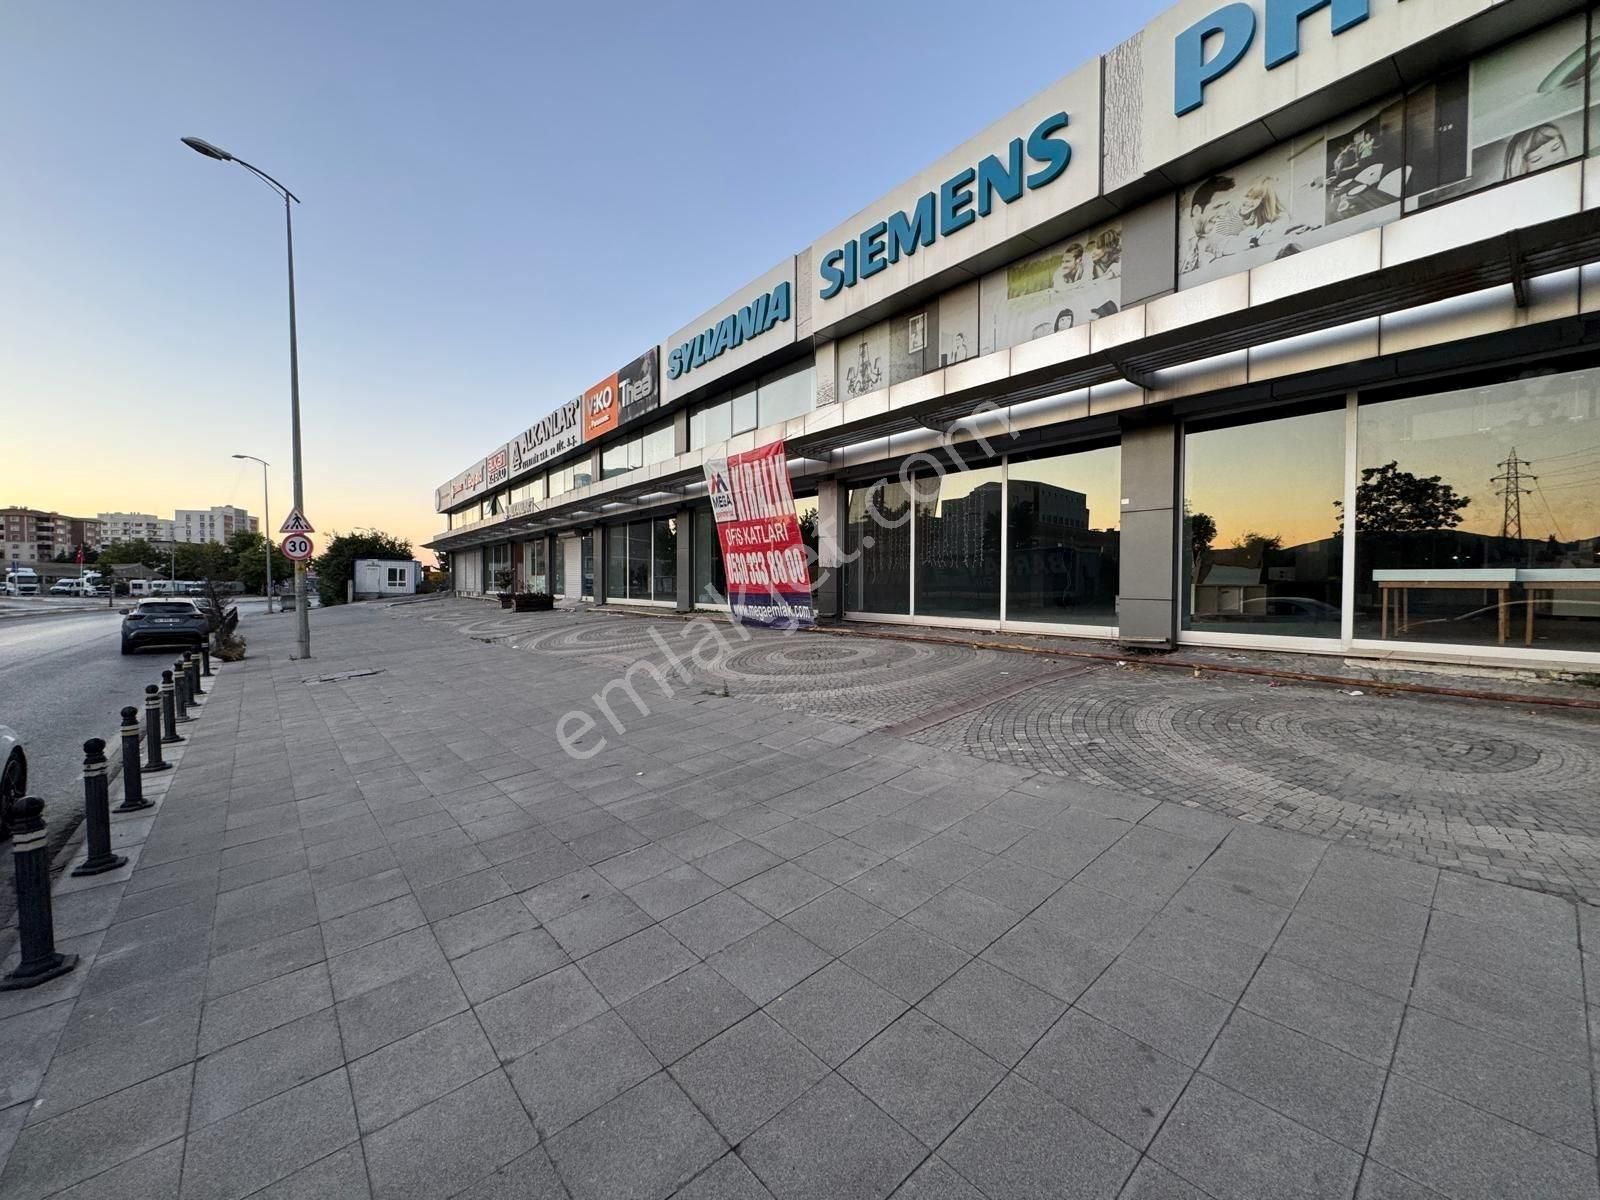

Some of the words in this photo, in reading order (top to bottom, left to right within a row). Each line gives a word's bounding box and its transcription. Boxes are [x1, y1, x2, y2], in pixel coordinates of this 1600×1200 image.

[819, 111, 1072, 300] SIEMENS
[667, 280, 791, 380] SYLVANIA
[619, 378, 652, 407] Thea
[288, 540, 308, 553] 30
[742, 522, 789, 545] KATLARI
[746, 551, 769, 585] 333
[767, 549, 788, 584] 88
[785, 548, 806, 583] 00
